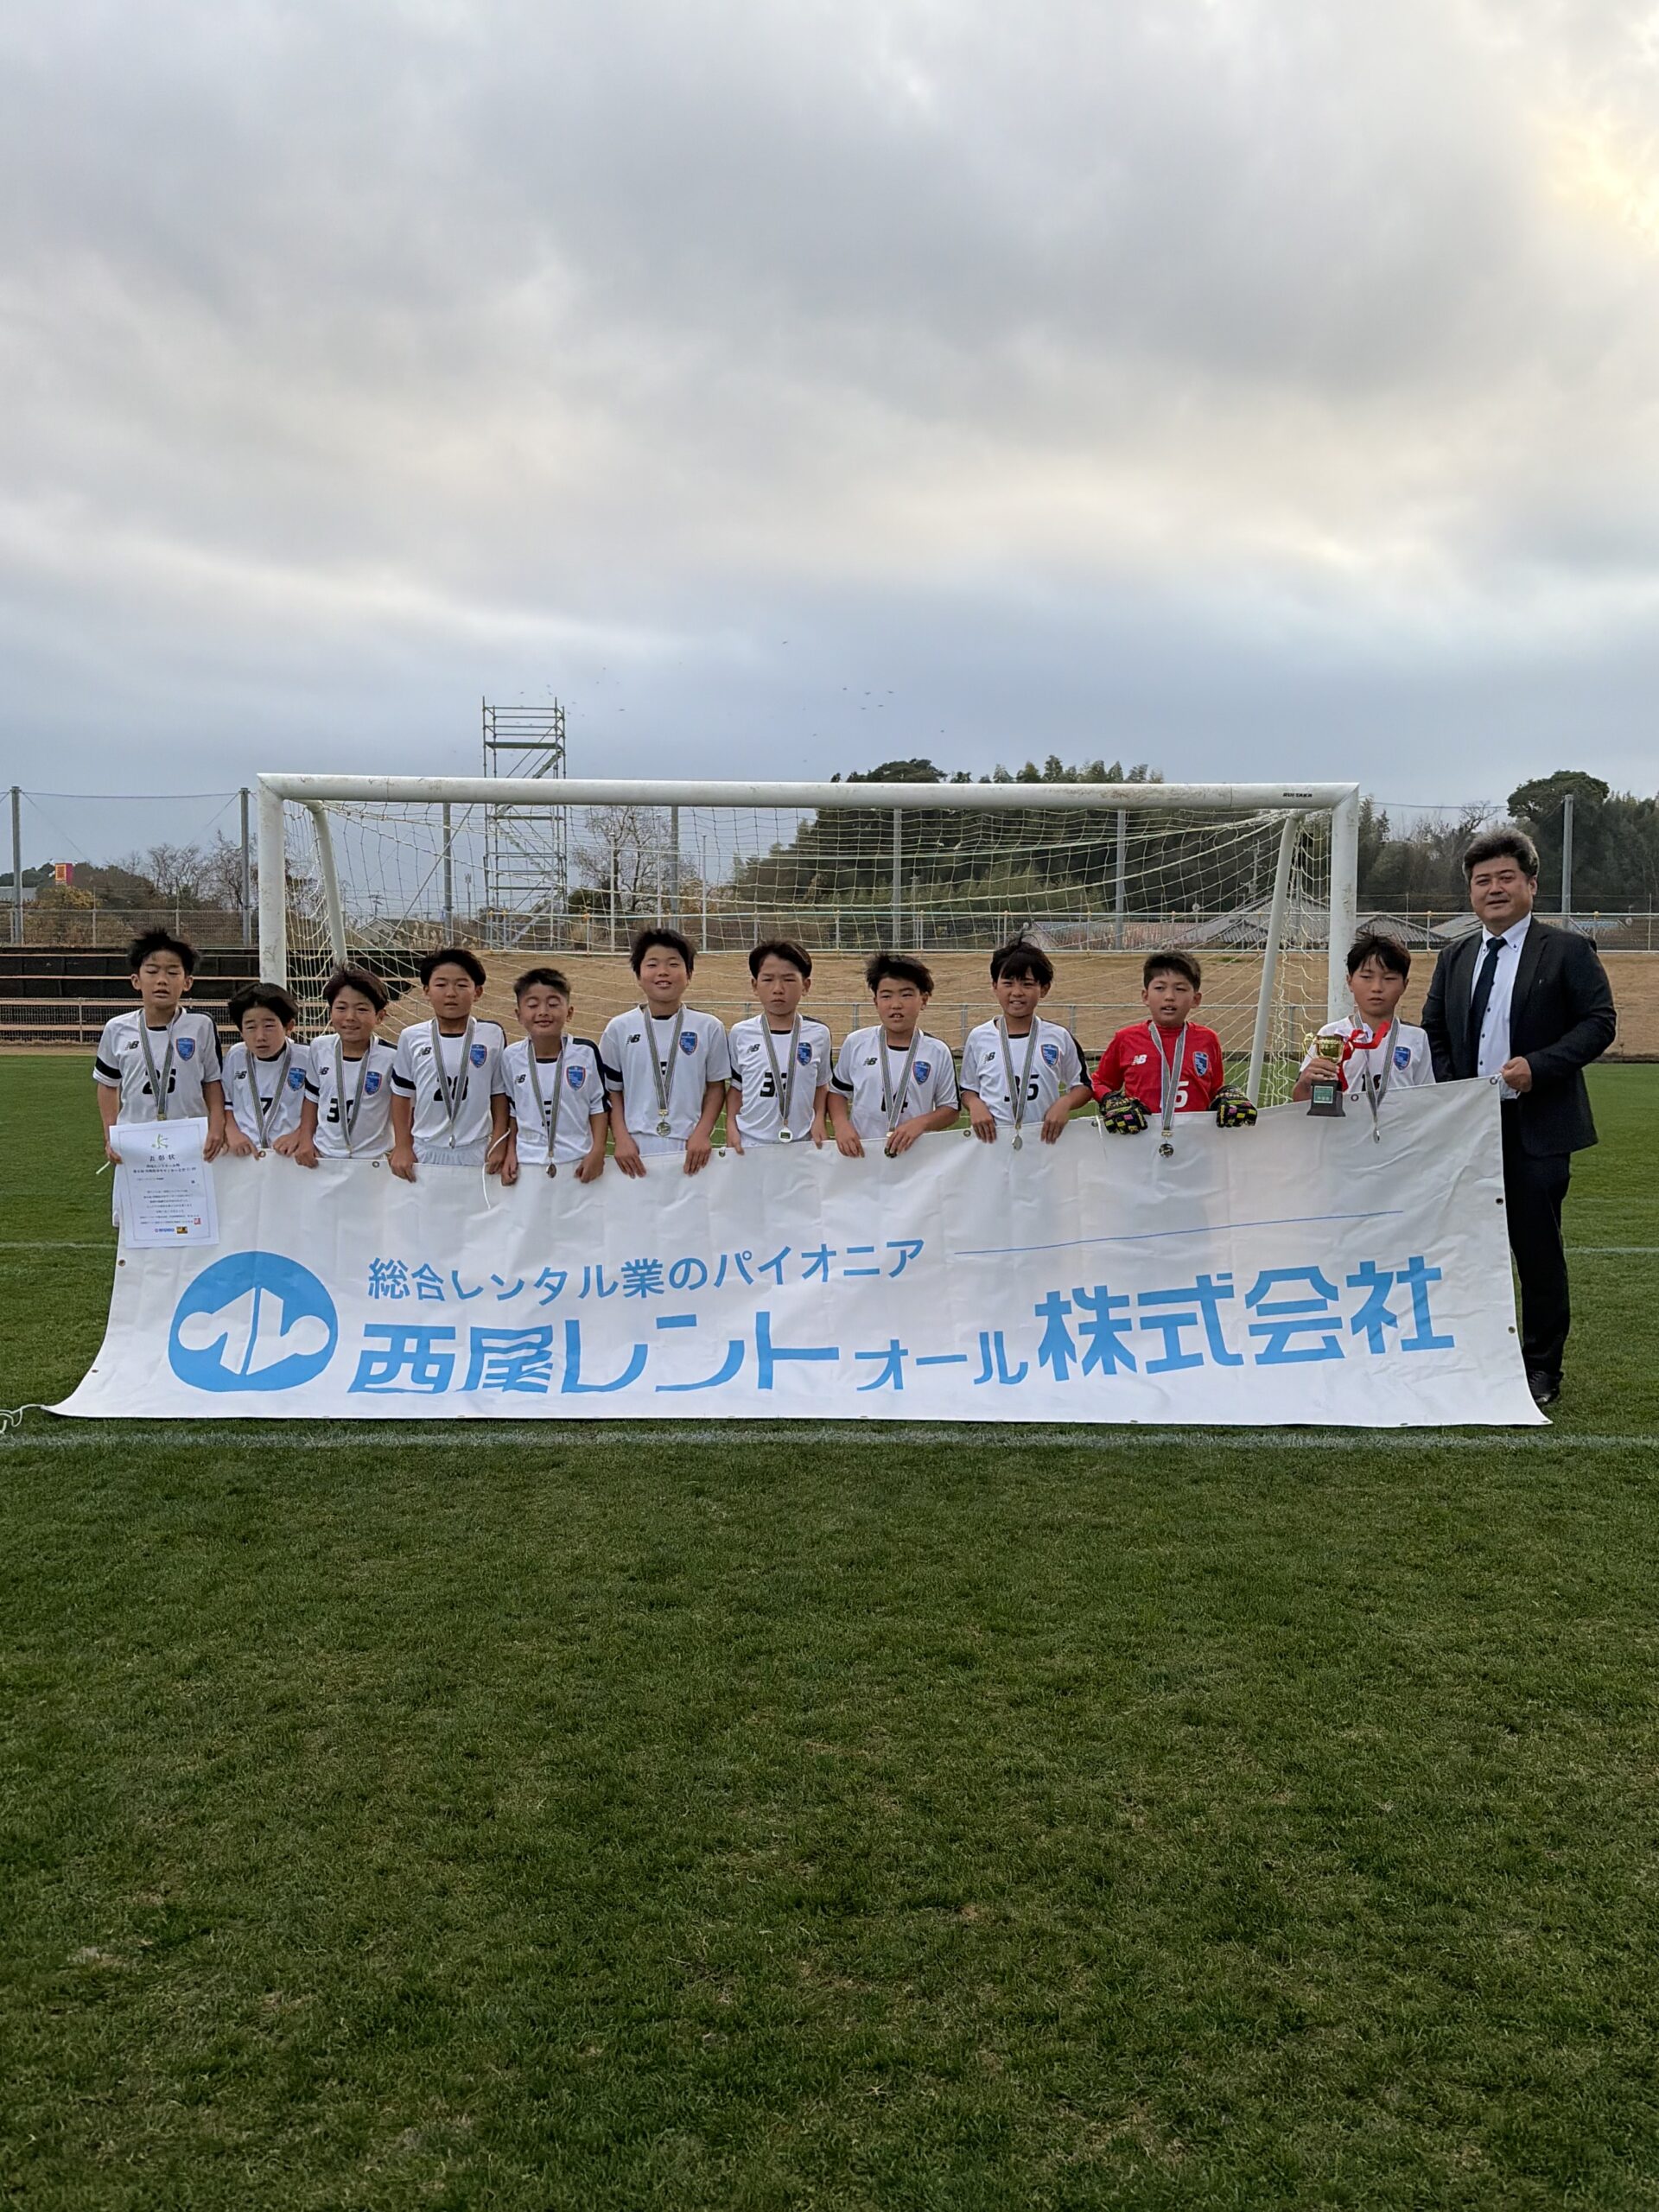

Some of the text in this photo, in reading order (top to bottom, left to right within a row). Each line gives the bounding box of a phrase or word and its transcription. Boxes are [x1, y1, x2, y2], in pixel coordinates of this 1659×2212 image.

[760, 1072, 787, 1097] 3
[367, 1238, 925, 1306] 総合レンタル業のパイオニア
[347, 1255, 1454, 1394] 西尾レントオール株式会社
